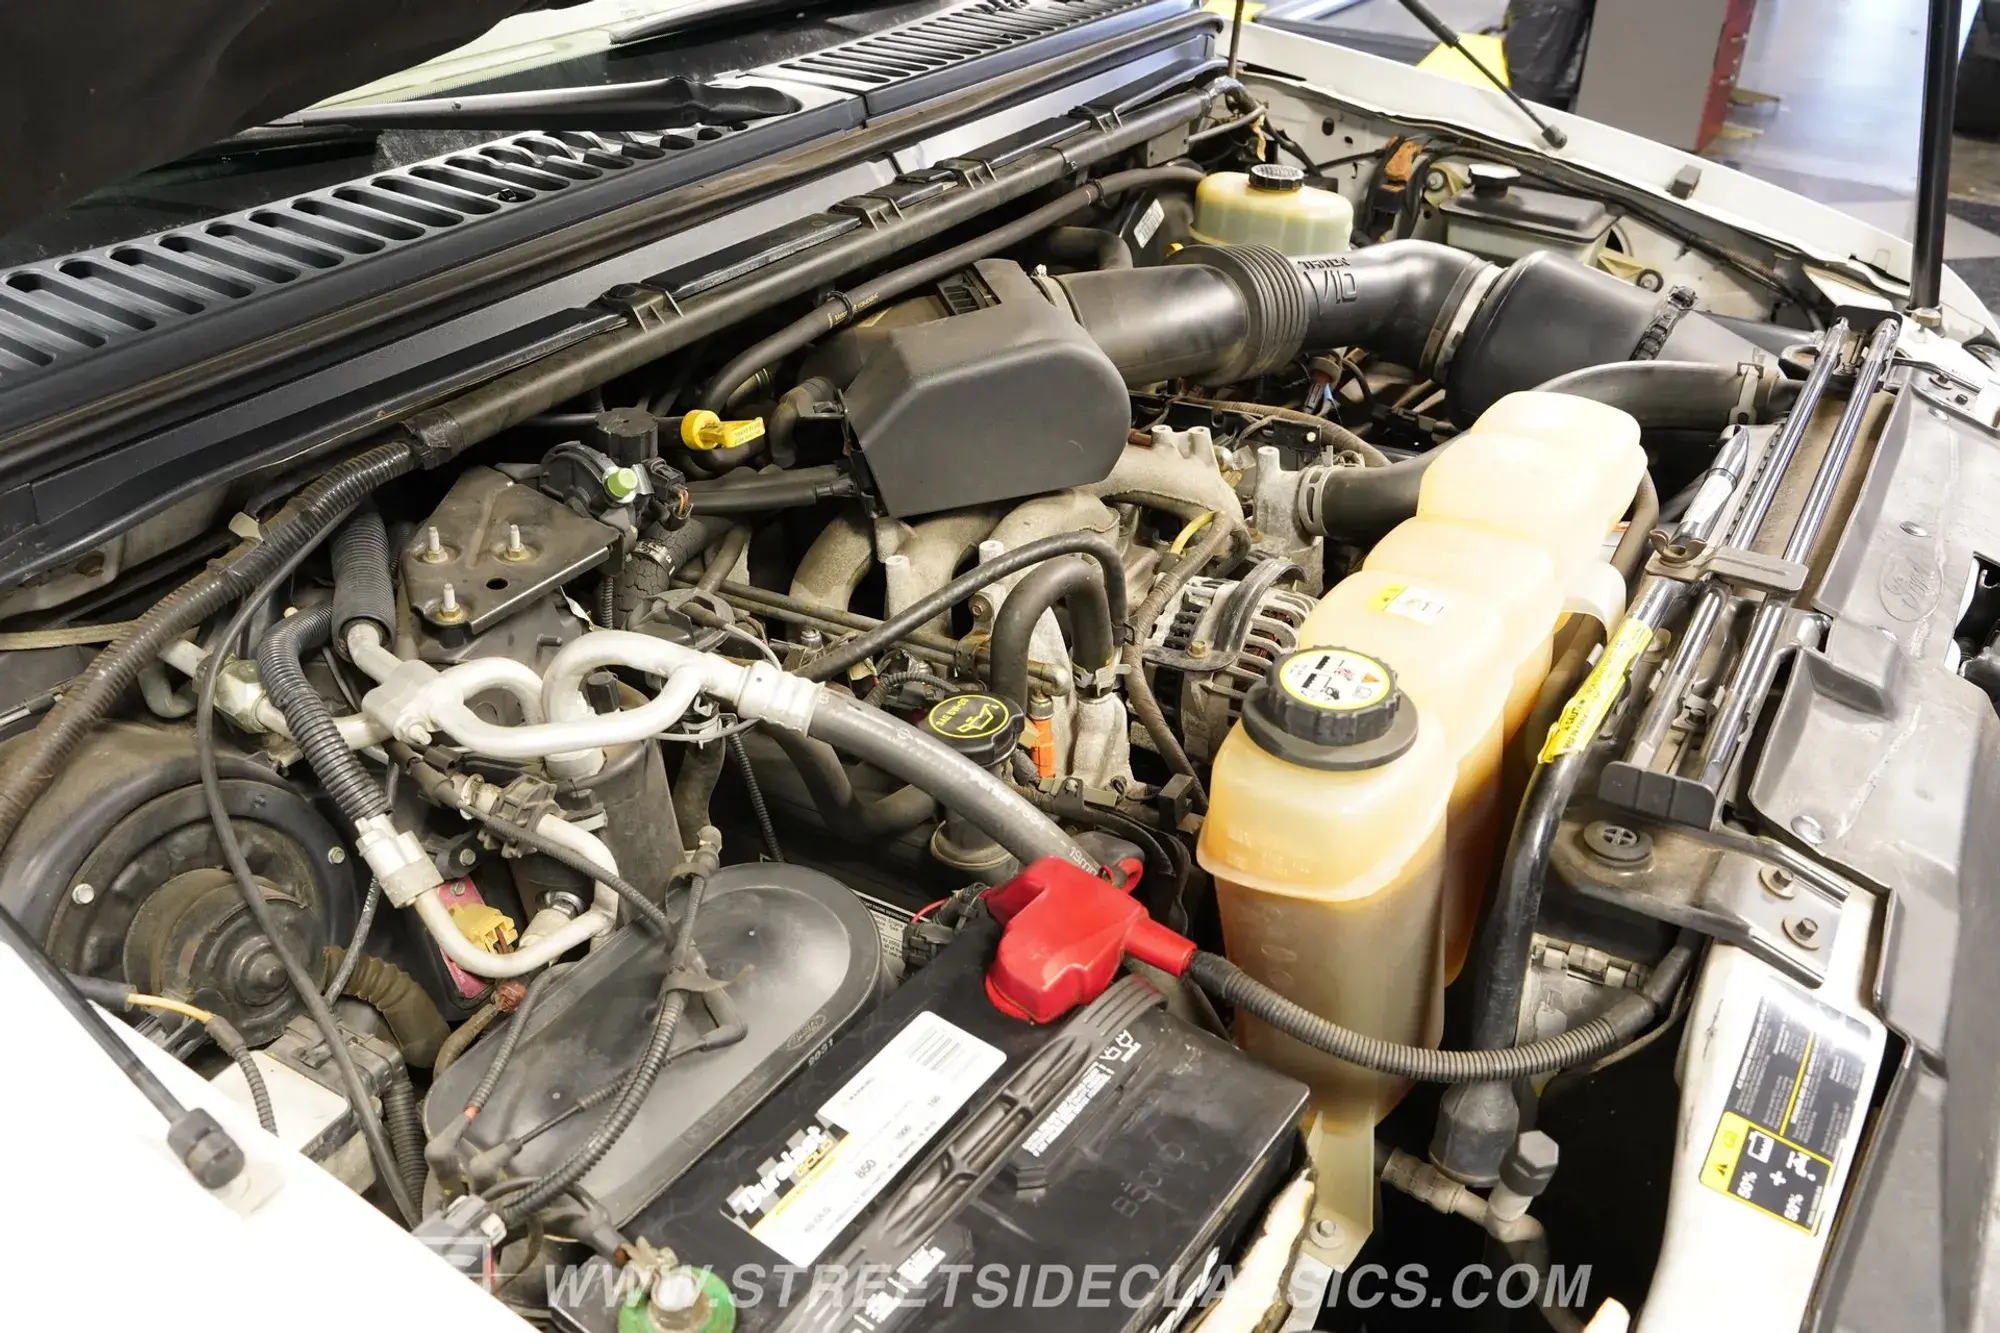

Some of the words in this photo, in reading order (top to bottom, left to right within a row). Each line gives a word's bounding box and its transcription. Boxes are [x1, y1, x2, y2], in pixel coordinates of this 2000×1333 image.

[1303, 270, 1357, 316] V10
[855, 1159, 876, 1180] 850
[1737, 1171, 1757, 1199] 50%
[1784, 1193, 1804, 1221] 50%
